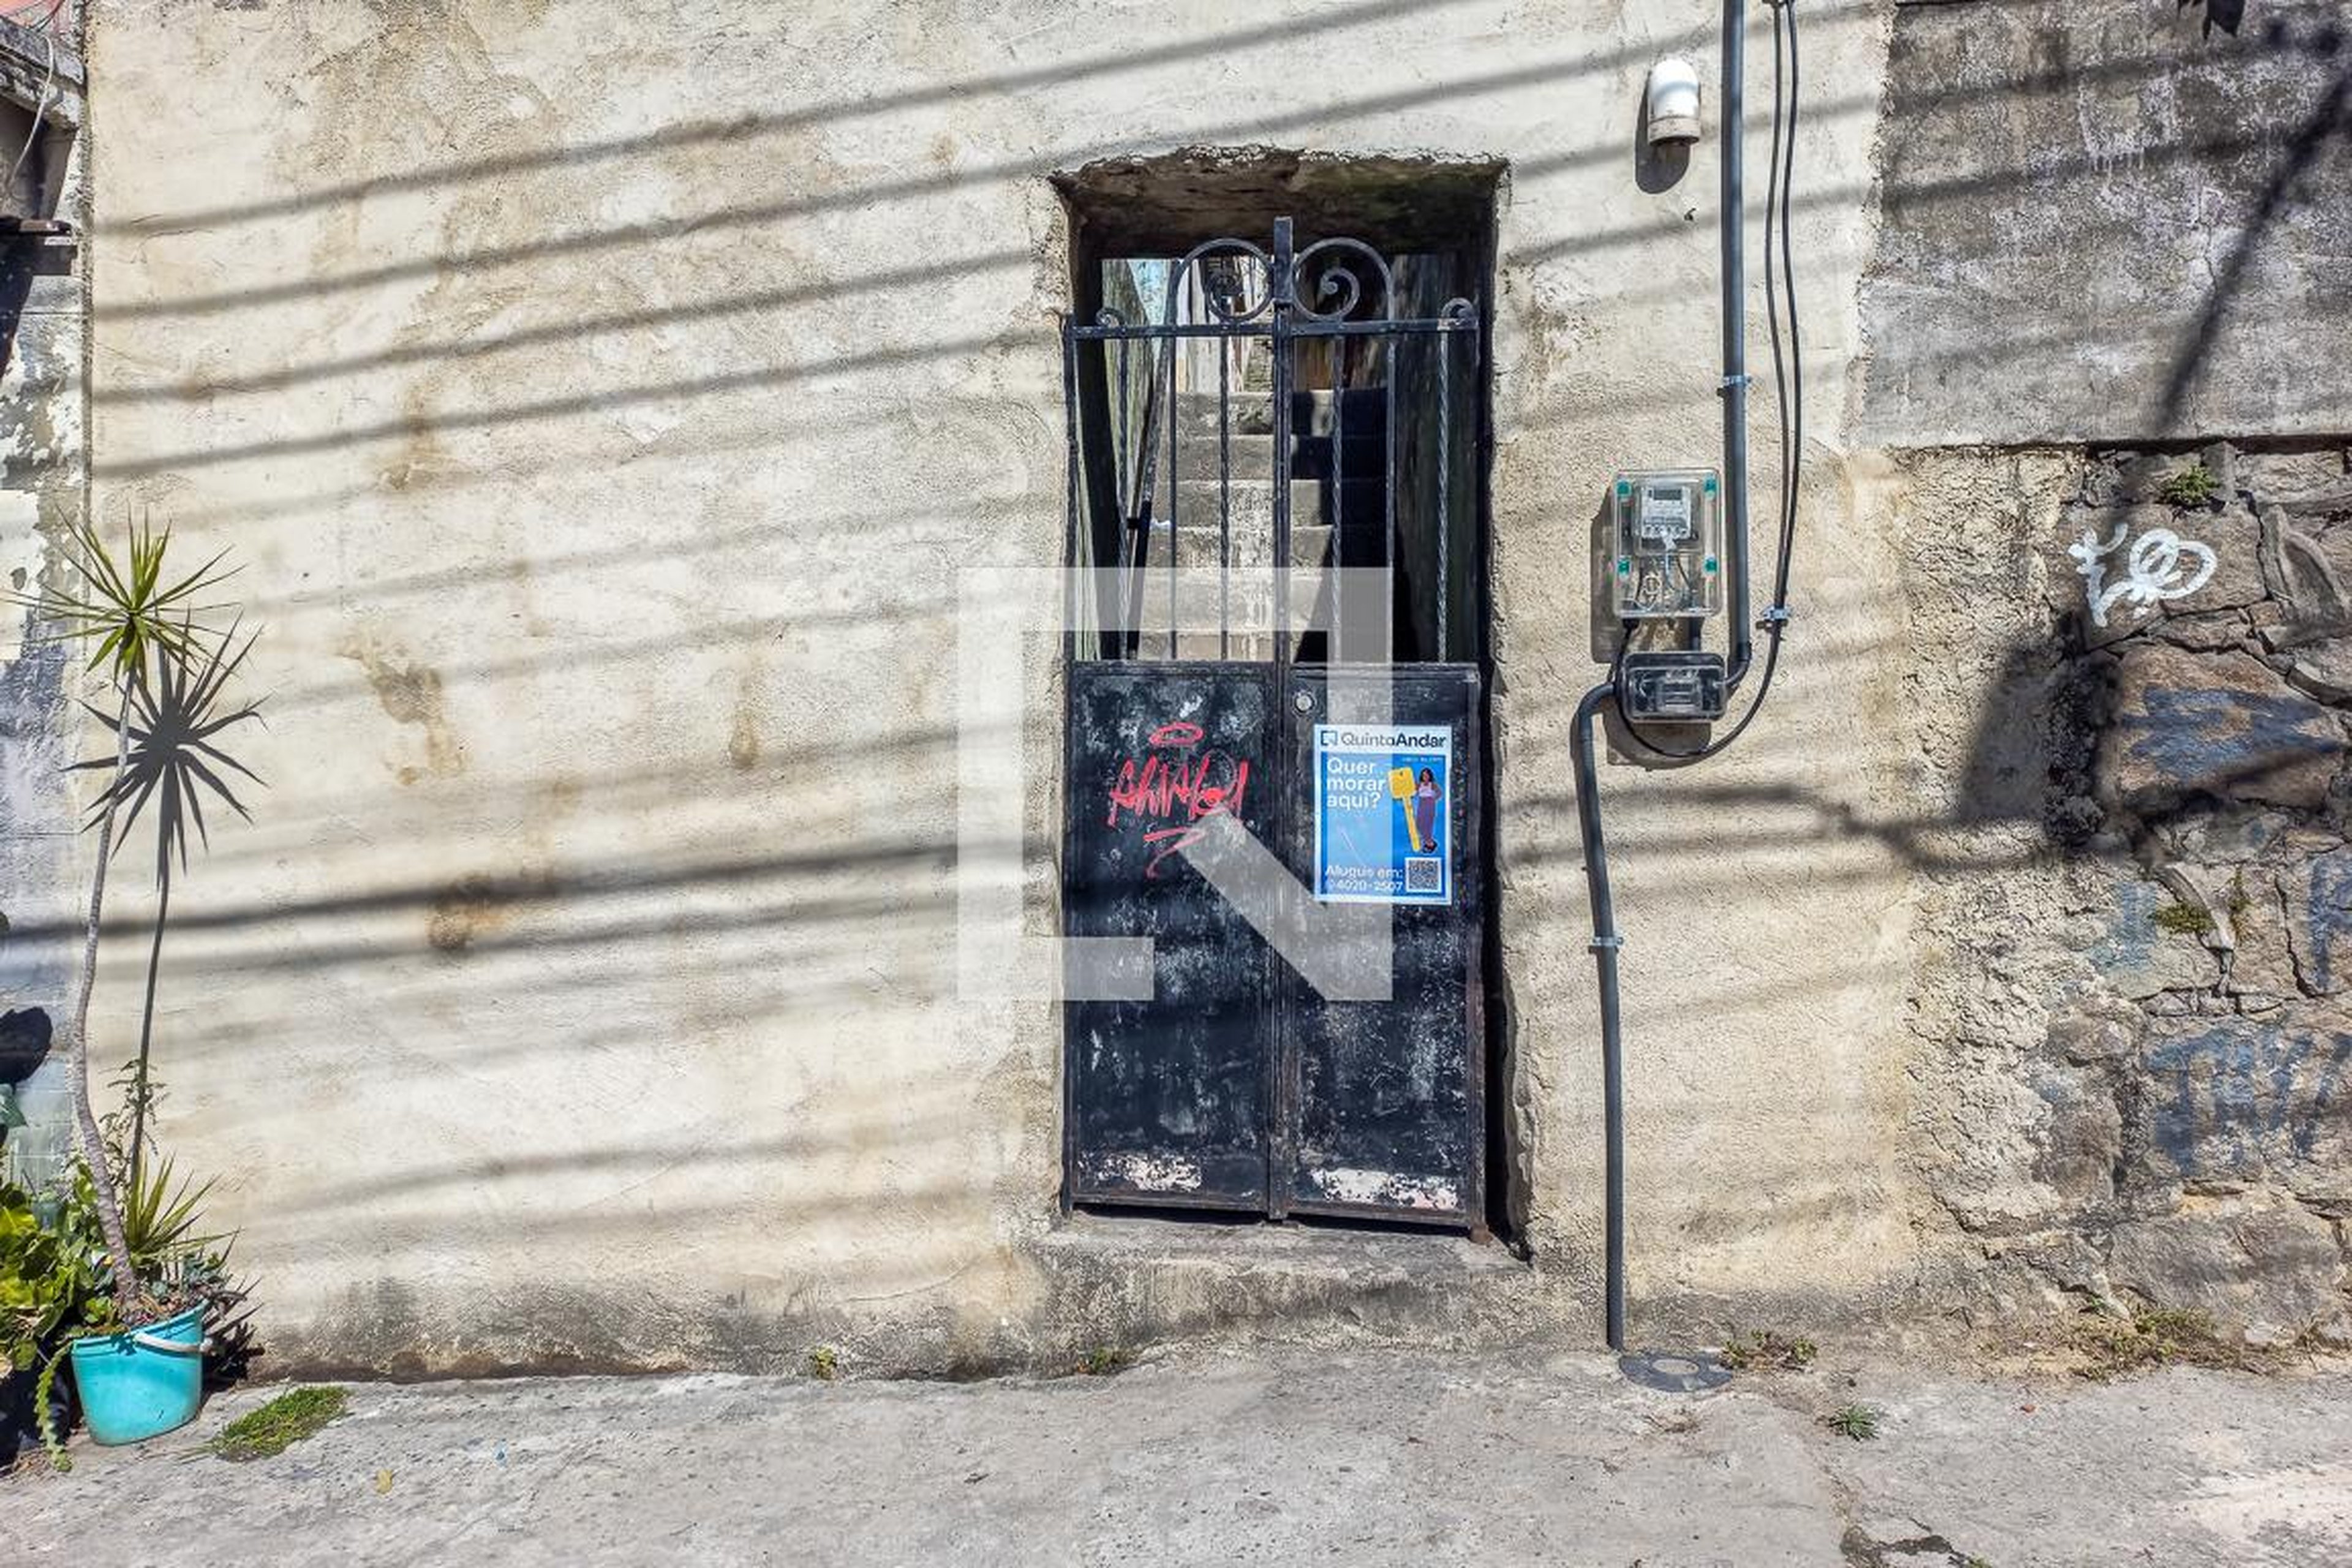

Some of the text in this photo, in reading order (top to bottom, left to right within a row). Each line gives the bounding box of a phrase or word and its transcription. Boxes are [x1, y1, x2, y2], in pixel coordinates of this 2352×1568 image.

[1341, 732, 1447, 748] QuintoAndar
[1327, 757, 1376, 775] Quer
[1327, 777, 1386, 791] morar
[1327, 792, 1381, 810] aqui?
